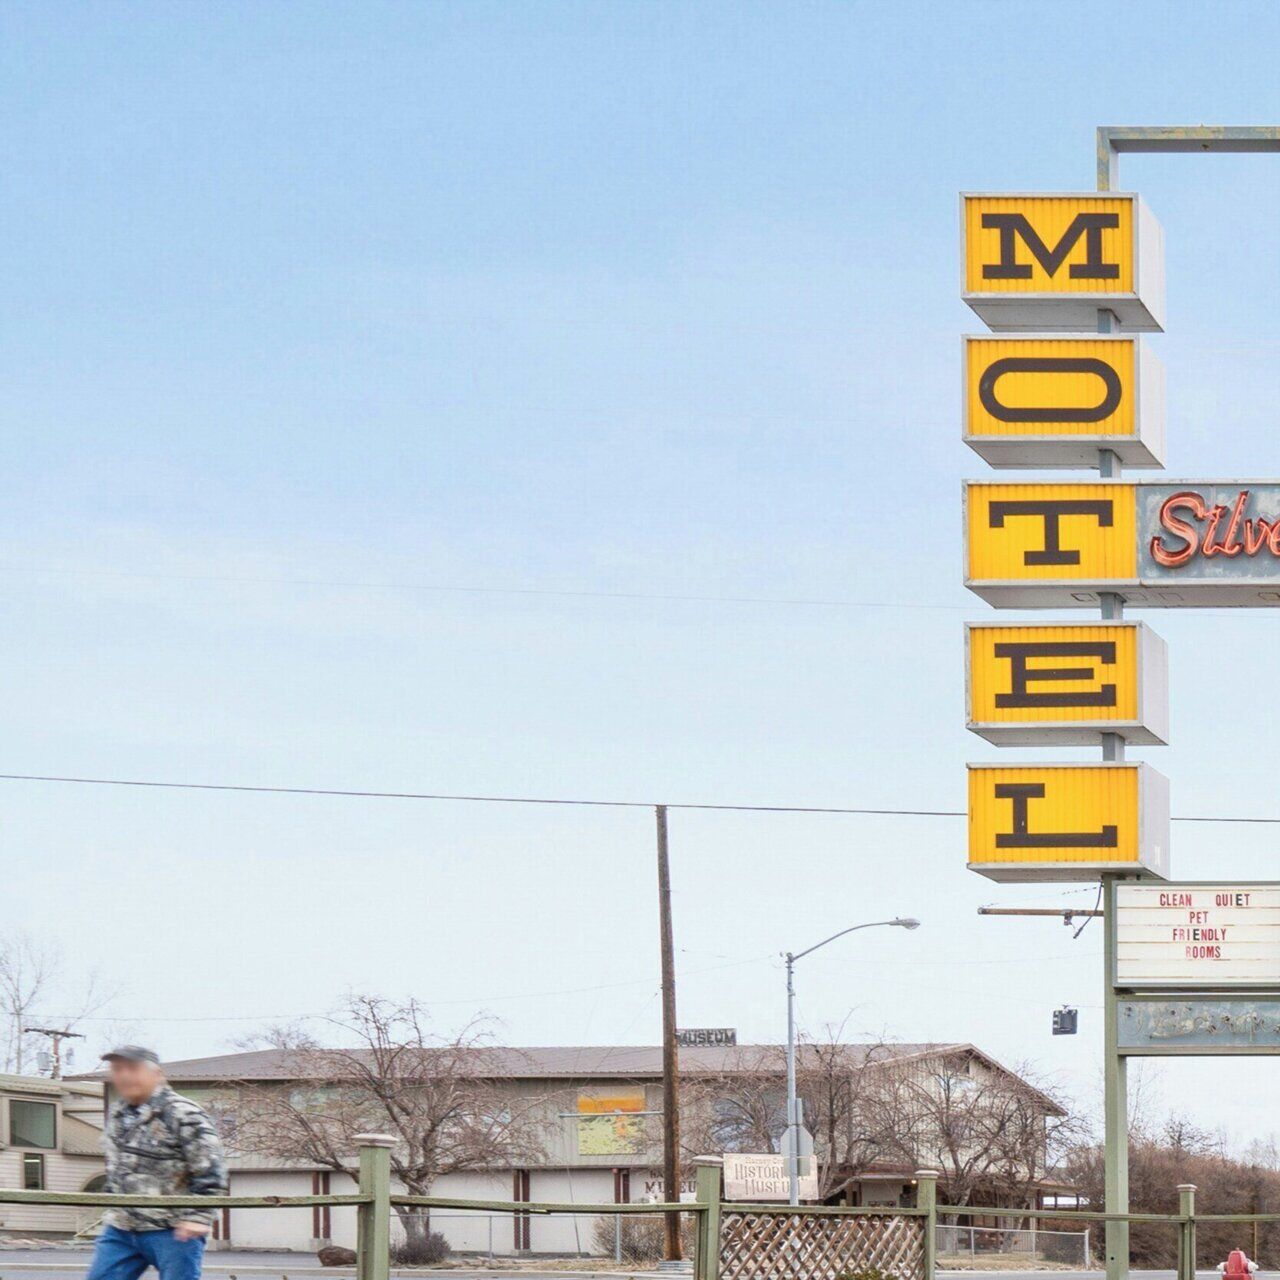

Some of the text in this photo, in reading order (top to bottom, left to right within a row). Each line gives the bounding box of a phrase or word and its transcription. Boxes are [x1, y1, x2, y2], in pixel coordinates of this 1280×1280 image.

[978, 212, 1122, 848] MOTEL
[1160, 893, 1250, 906] CLEAN QUIET
[1189, 911, 1209, 924] PET
[1173, 928, 1227, 941] FRIENDLY
[1185, 946, 1221, 958] ROOMS
